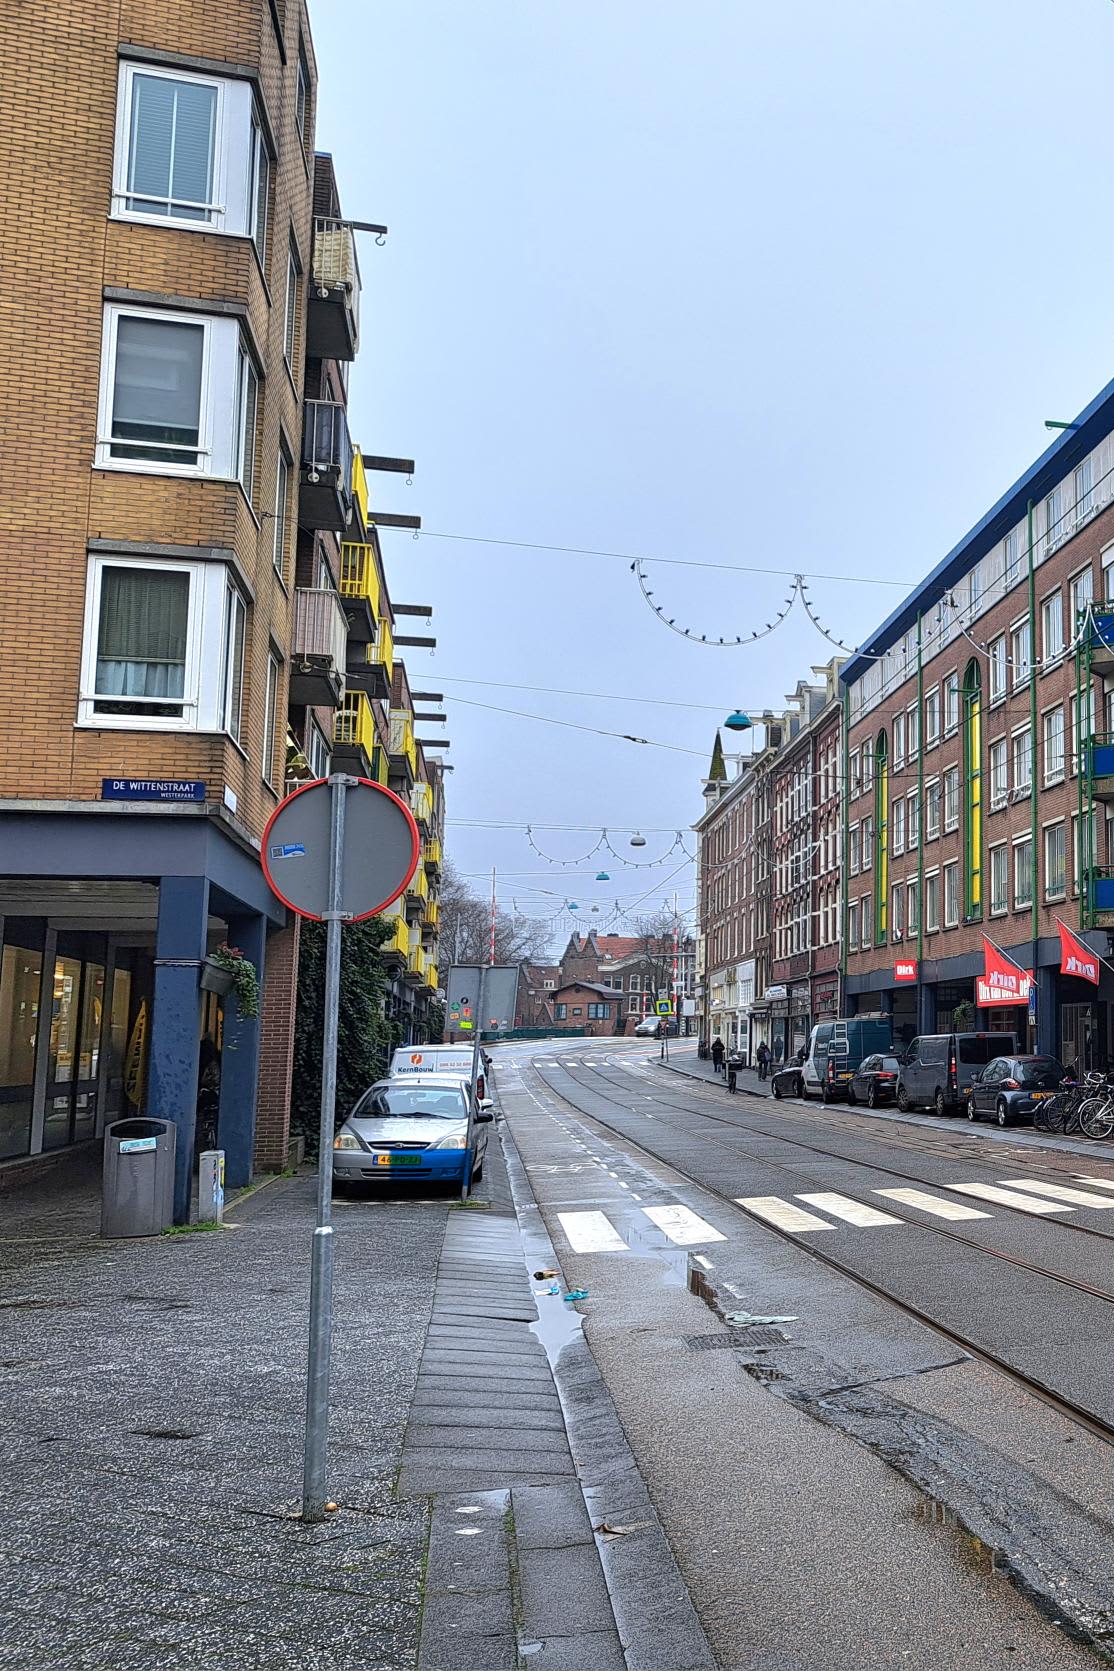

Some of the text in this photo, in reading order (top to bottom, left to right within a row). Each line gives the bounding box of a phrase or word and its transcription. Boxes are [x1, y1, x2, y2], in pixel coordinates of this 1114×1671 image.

[113, 781, 196, 792] DE WITTENSTRAAT
[896, 965, 914, 975] Dirk
[397, 1065, 434, 1073] KernBouw
